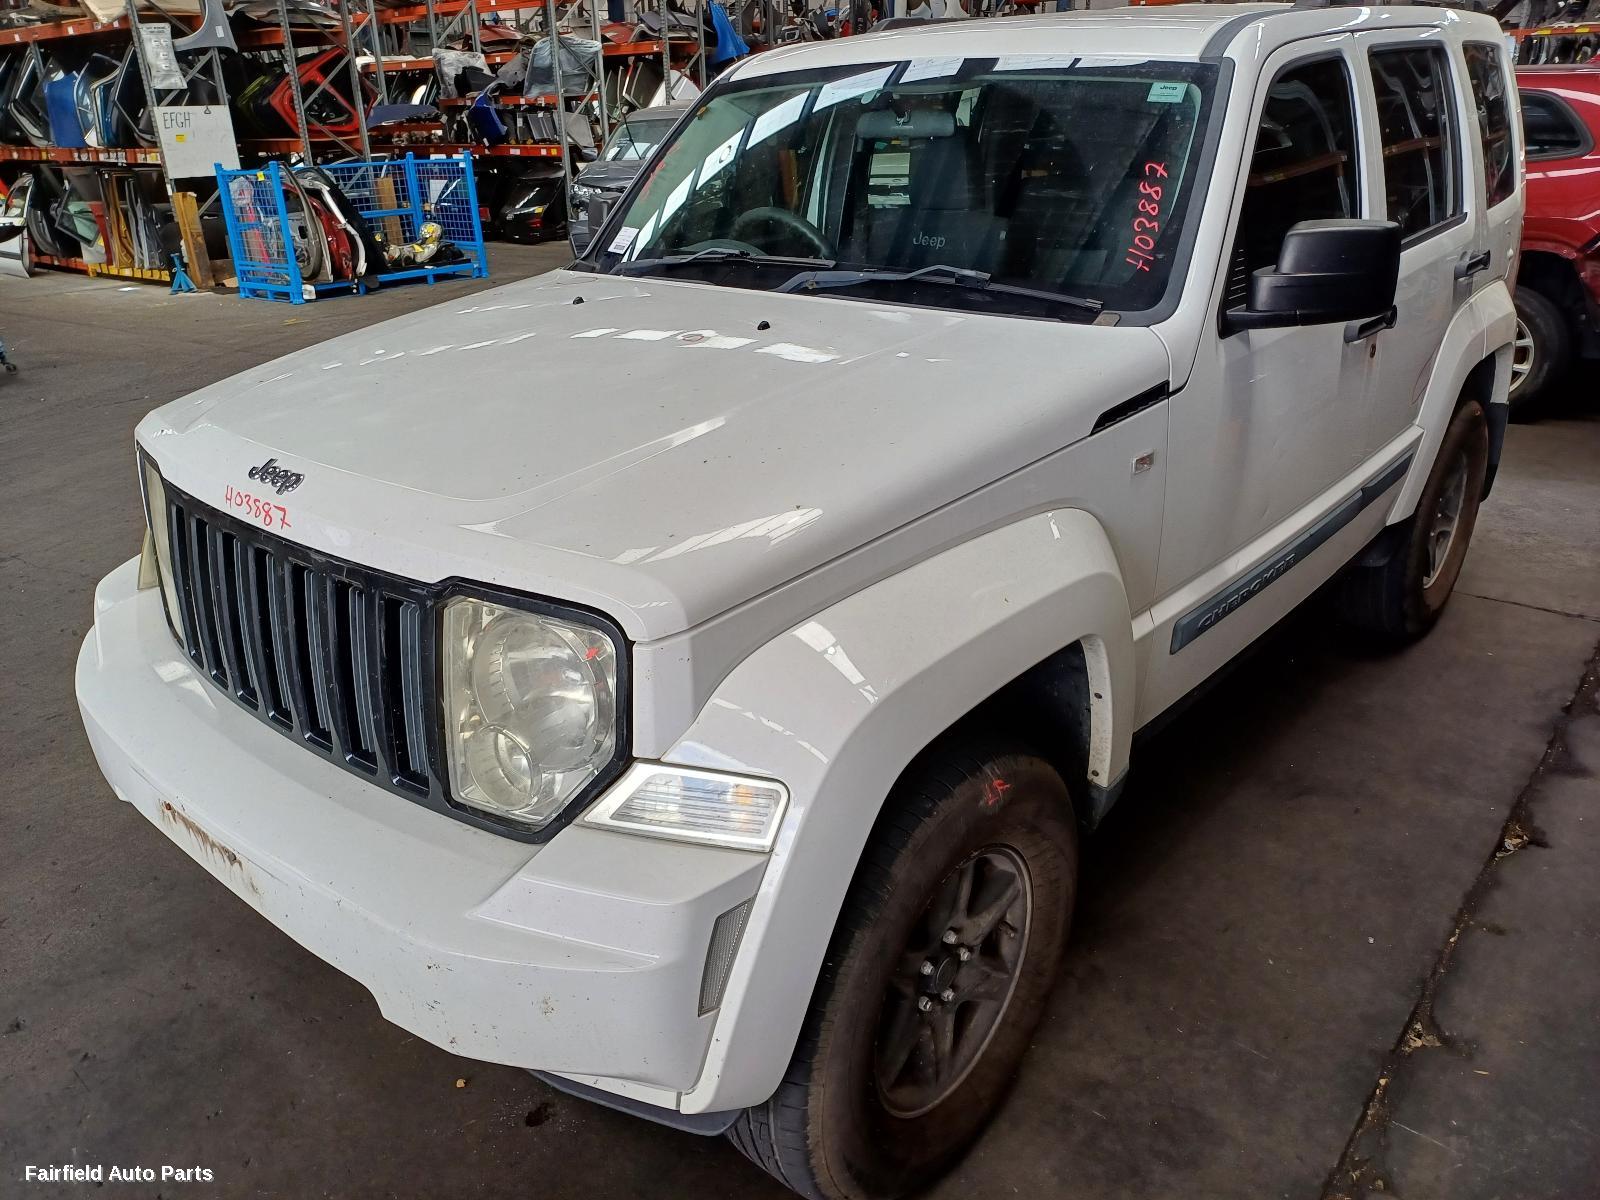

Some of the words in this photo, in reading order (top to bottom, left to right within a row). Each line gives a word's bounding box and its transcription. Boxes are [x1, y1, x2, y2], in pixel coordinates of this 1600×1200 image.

[163, 112, 191, 129] EFGH
[913, 231, 945, 250] Jeep
[248, 458, 304, 495] Jeep
[1198, 553, 1296, 627] CHEROKEE
